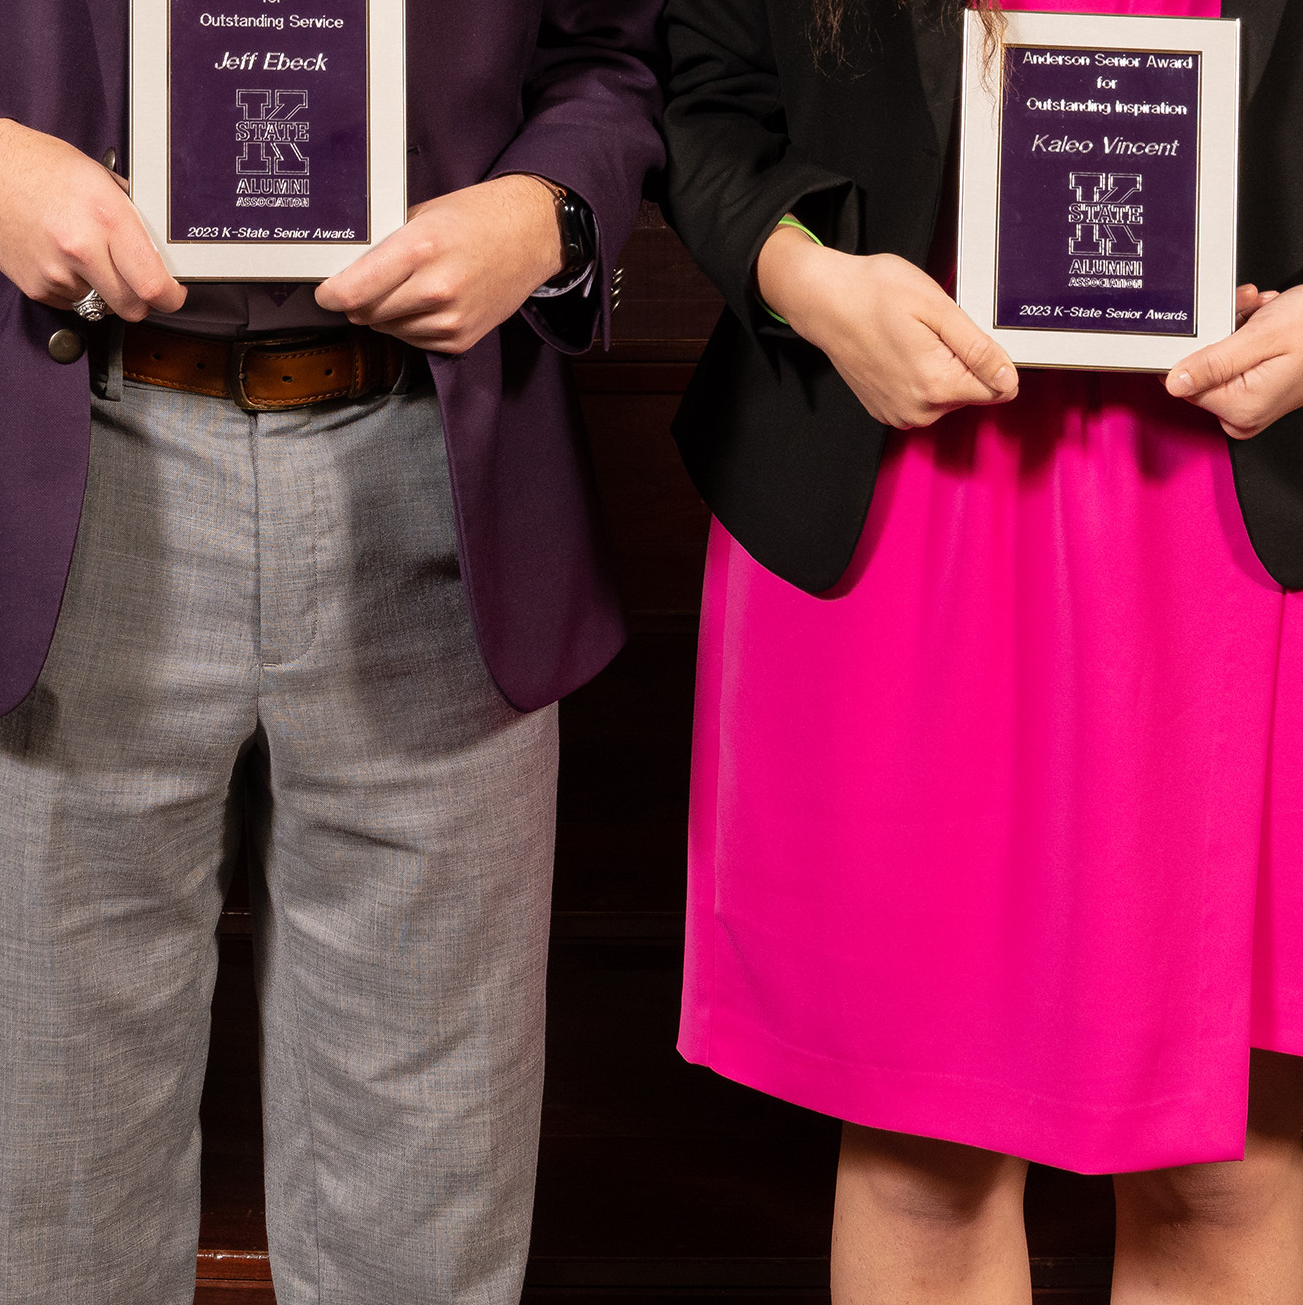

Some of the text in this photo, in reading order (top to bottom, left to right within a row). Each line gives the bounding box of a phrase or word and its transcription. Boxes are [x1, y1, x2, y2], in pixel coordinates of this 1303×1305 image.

[199, 13, 344, 30] Outstanding Service
[214, 52, 329, 71] Jeff Ebeck
[1022, 51, 1193, 69] Anderson Senior Award
[1096, 76, 1118, 90] for
[1026, 98, 1188, 116] Outstanding Inspiration
[235, 121, 310, 142] STATE
[1031, 135, 1180, 156] Kaleo Vincent
[236, 178, 310, 195] ALUMNI
[235, 197, 310, 208] ASSOCIATION
[1068, 203, 1143, 225] STATE
[187, 227, 356, 239] 2023 K-State Senior Awards
[1068, 259, 1143, 276] ALUMNI
[1068, 277, 1143, 289] ASSOCIATION
[1019, 305, 1188, 322] 2023 K-State Senior Awards
